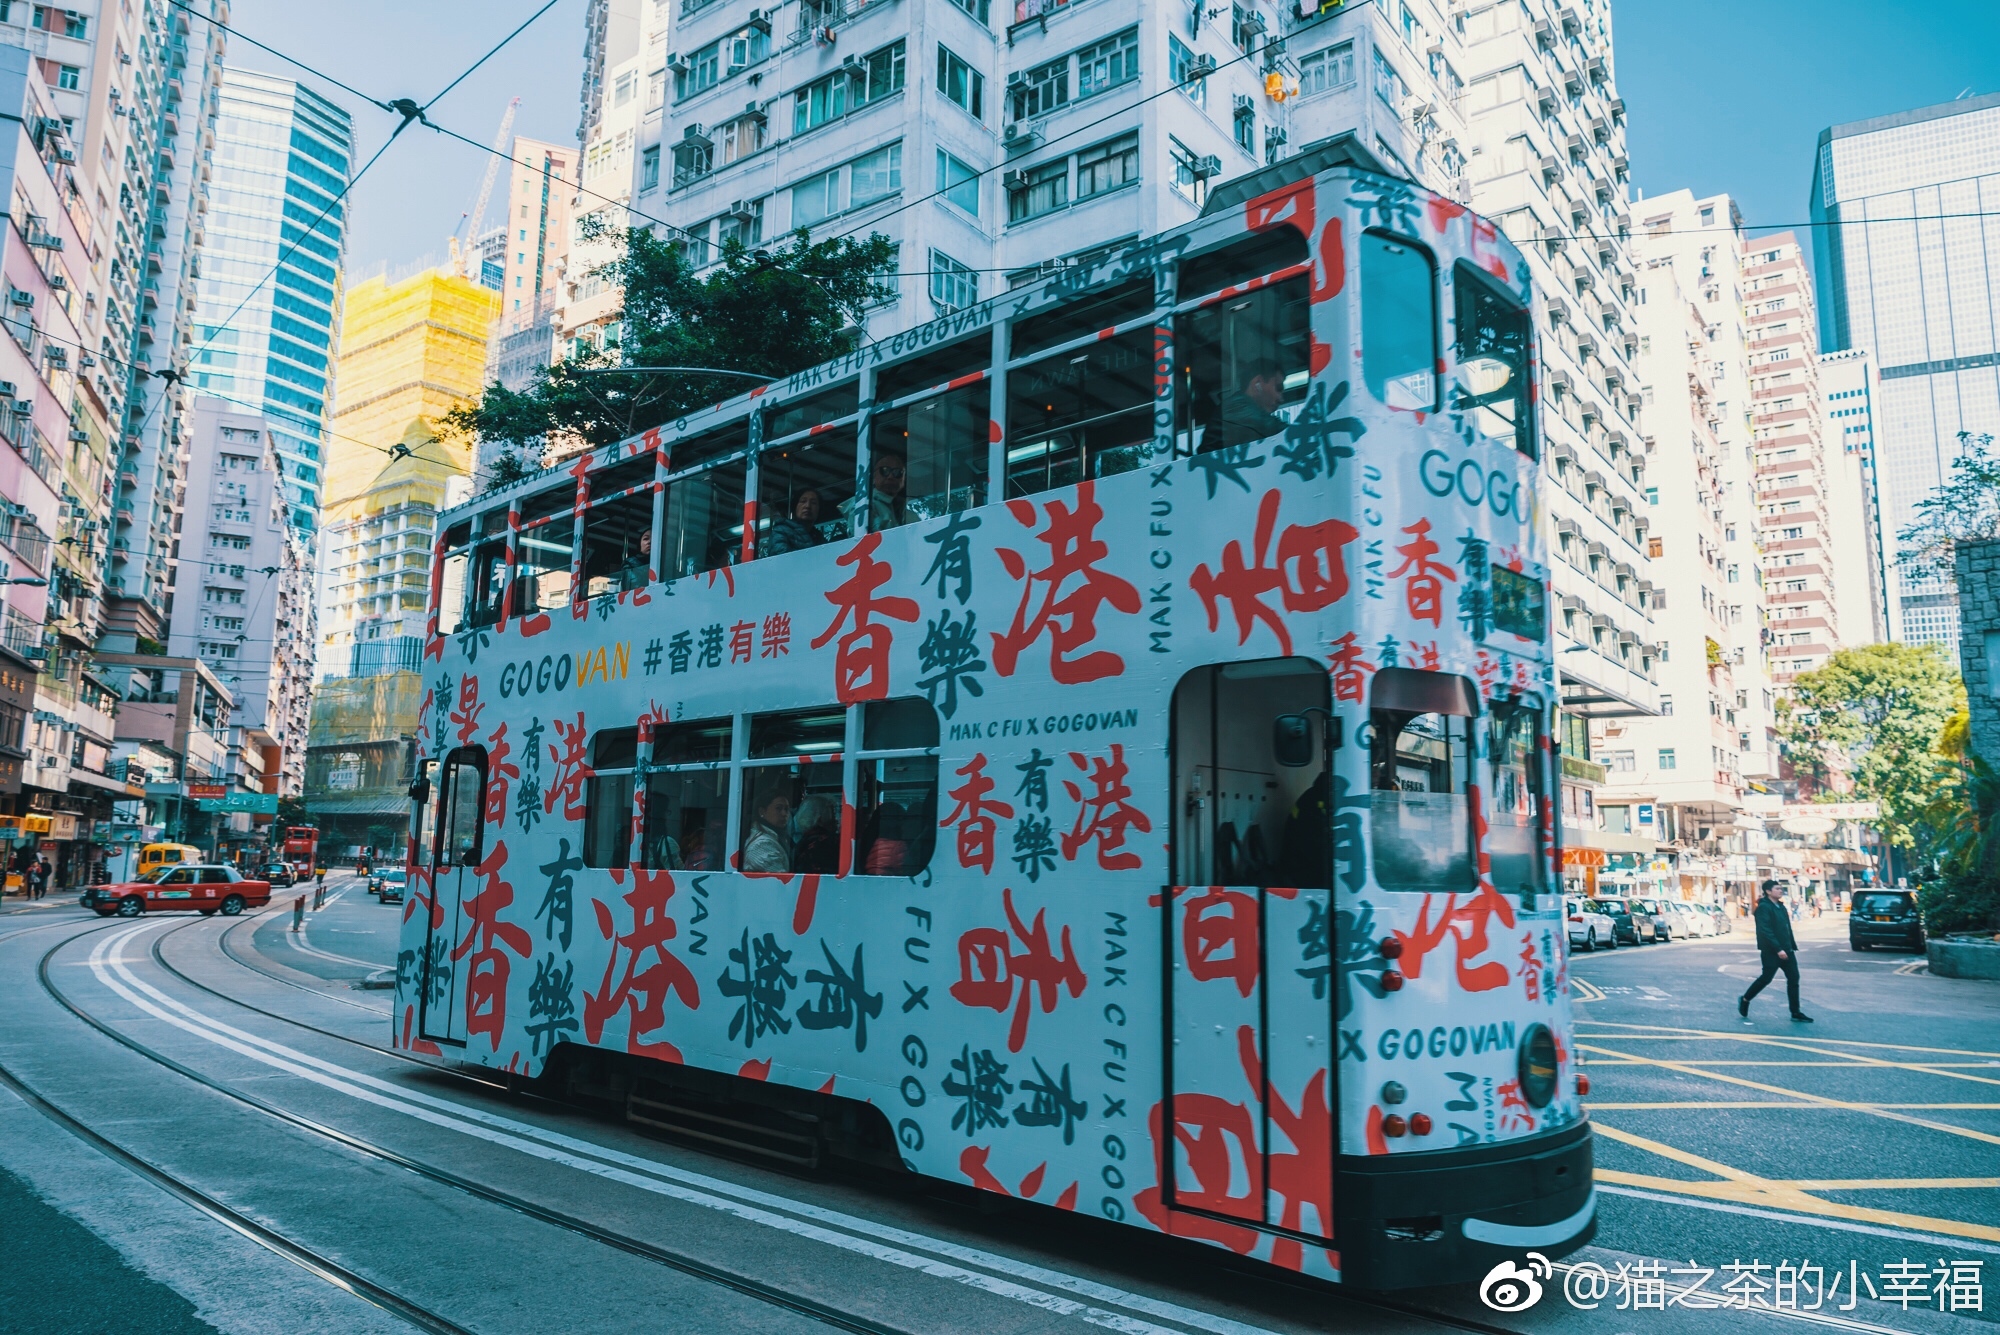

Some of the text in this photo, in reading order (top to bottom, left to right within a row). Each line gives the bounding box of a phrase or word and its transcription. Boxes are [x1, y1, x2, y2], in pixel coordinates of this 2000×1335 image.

[788, 365, 822, 395] MAK
[828, 358, 840, 379] C
[870, 342, 883, 365] X
[892, 303, 993, 357] GOGOVAN
[1150, 464, 1173, 488] X
[1150, 500, 1173, 537] FU
[1150, 550, 1173, 570] C
[1362, 465, 1384, 600] MAK C FU
[1387, 517, 1457, 629] 香
[810, 479, 1143, 720] 香 有樂 港
[1149, 582, 1172, 654] MAK
[500, 641, 631, 699] GOGOVAN
[643, 611, 791, 677] #香港有樂
[1325, 631, 1377, 705] 香
[949, 708, 1138, 742] MAK C FU X GOGOVAN
[515, 716, 545, 835] 有樂
[544, 711, 599, 822] 港
[939, 743, 1152, 884] 香 有樂 港
[450, 838, 701, 1066] 香 有樂 港
[688, 875, 711, 956] VAN
[903, 906, 932, 964] FU
[717, 926, 884, 1053] 有樂
[901, 980, 929, 1013] X
[949, 888, 1088, 1053] 香
[1101, 911, 1128, 1222] MAK C FU X GOG
[1338, 1021, 1515, 1062] X GOGOVAN
[940, 1042, 1088, 1147] 有樂
